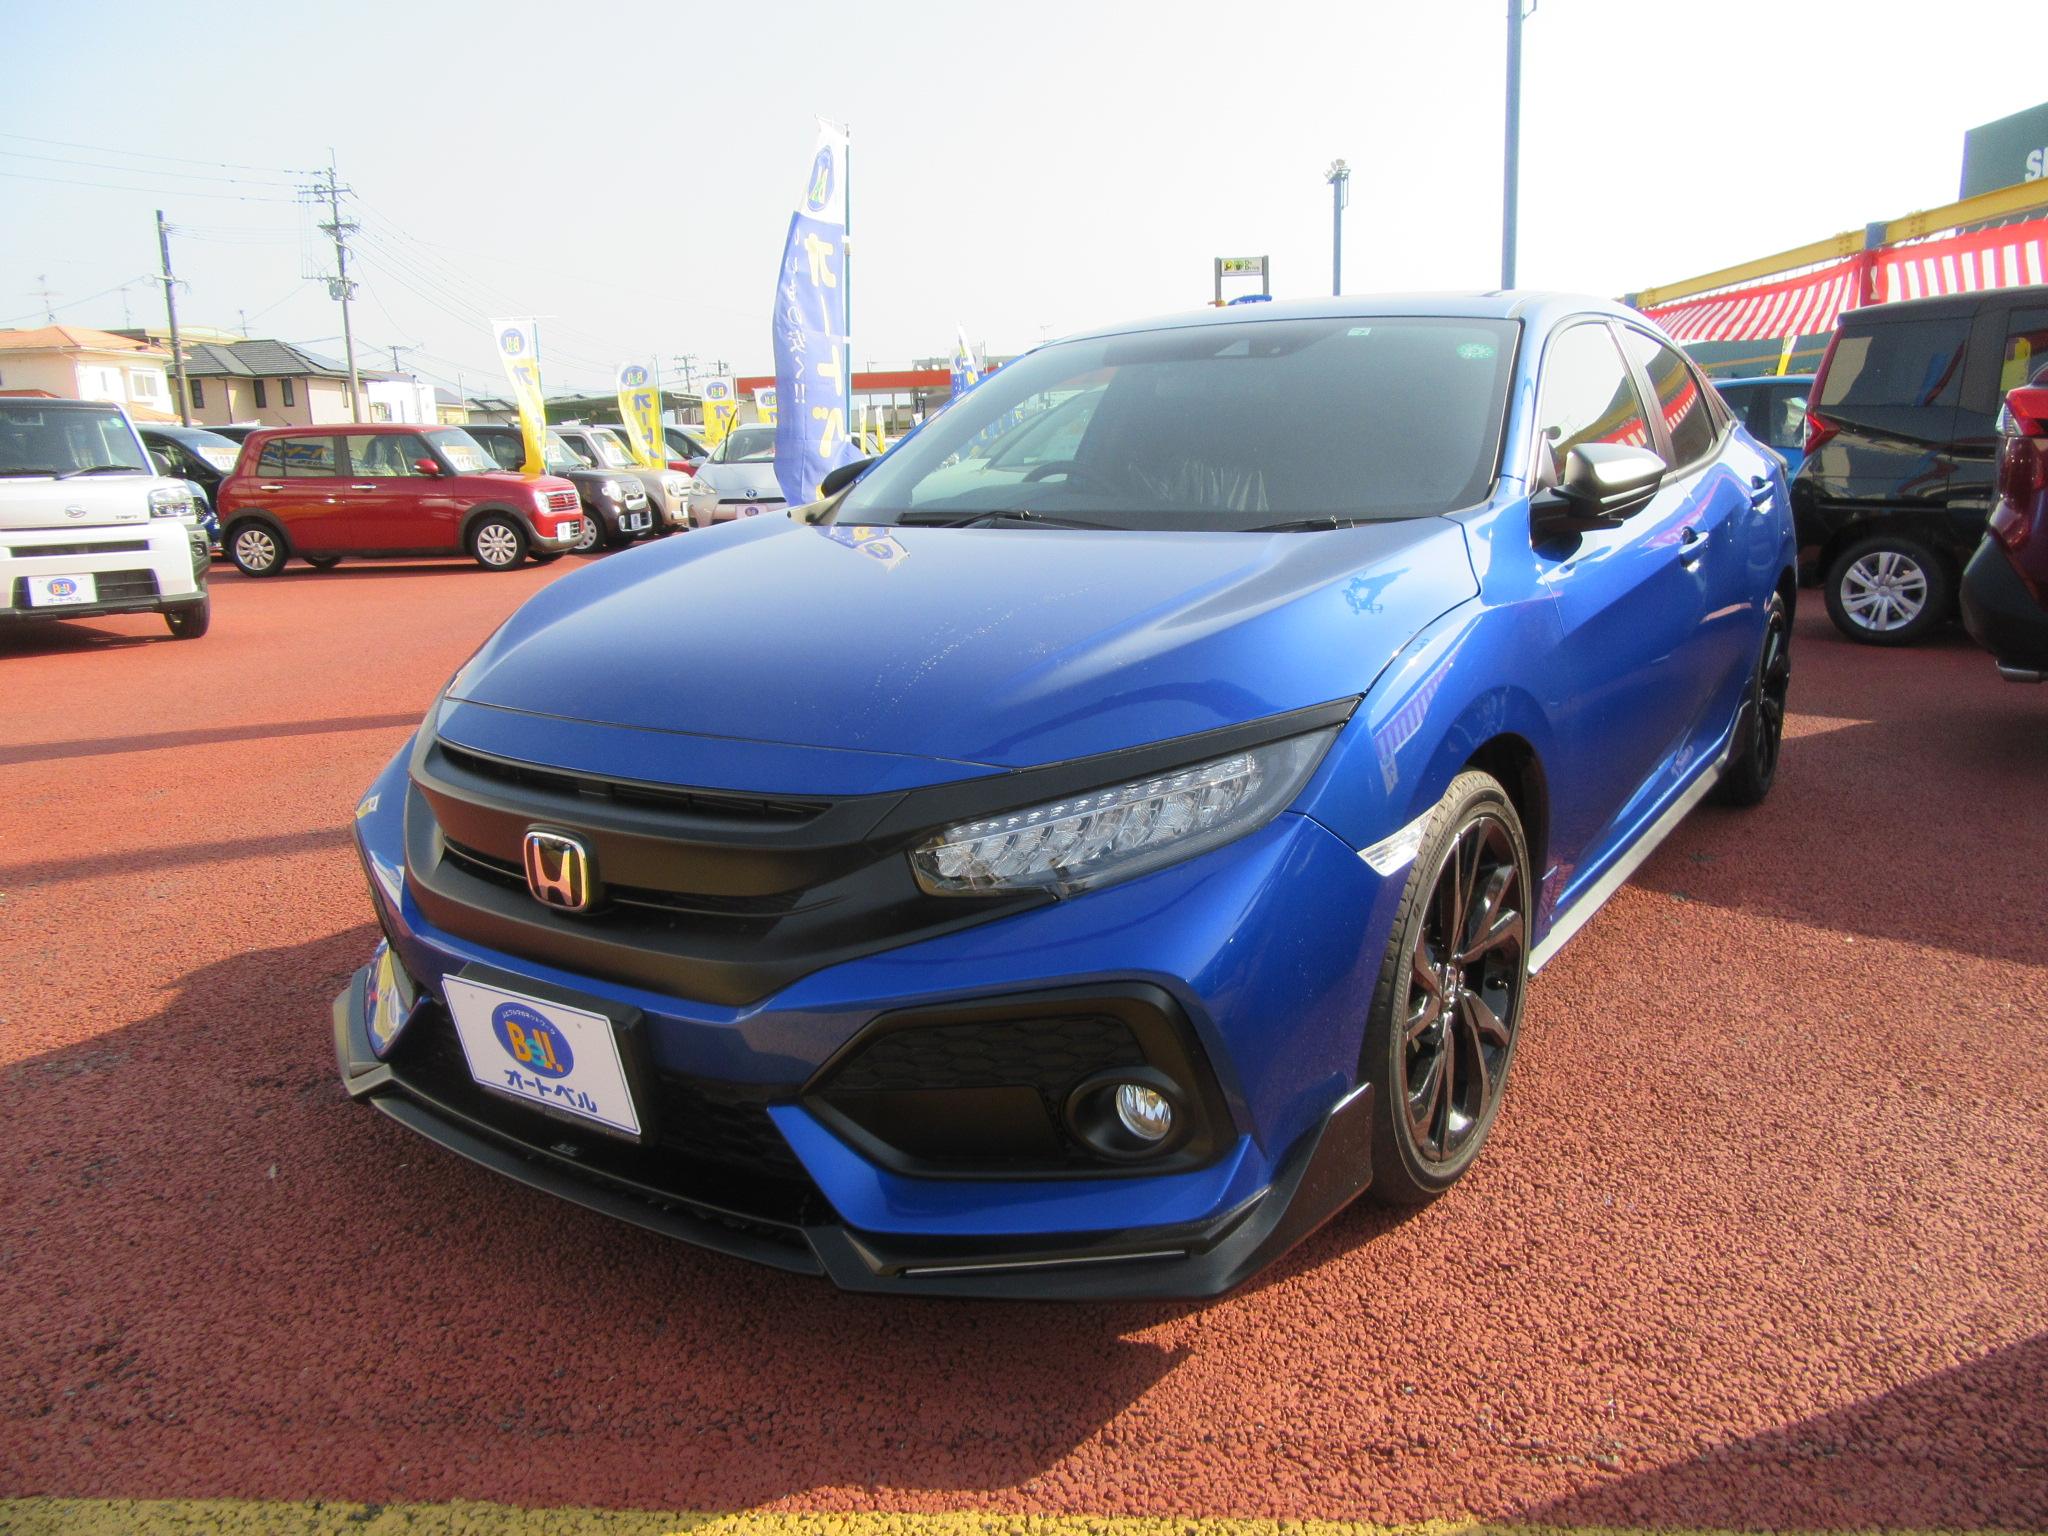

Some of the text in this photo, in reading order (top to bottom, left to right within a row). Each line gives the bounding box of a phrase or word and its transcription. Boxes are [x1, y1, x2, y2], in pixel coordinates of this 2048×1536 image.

[504, 1069, 598, 1113] オートベル
